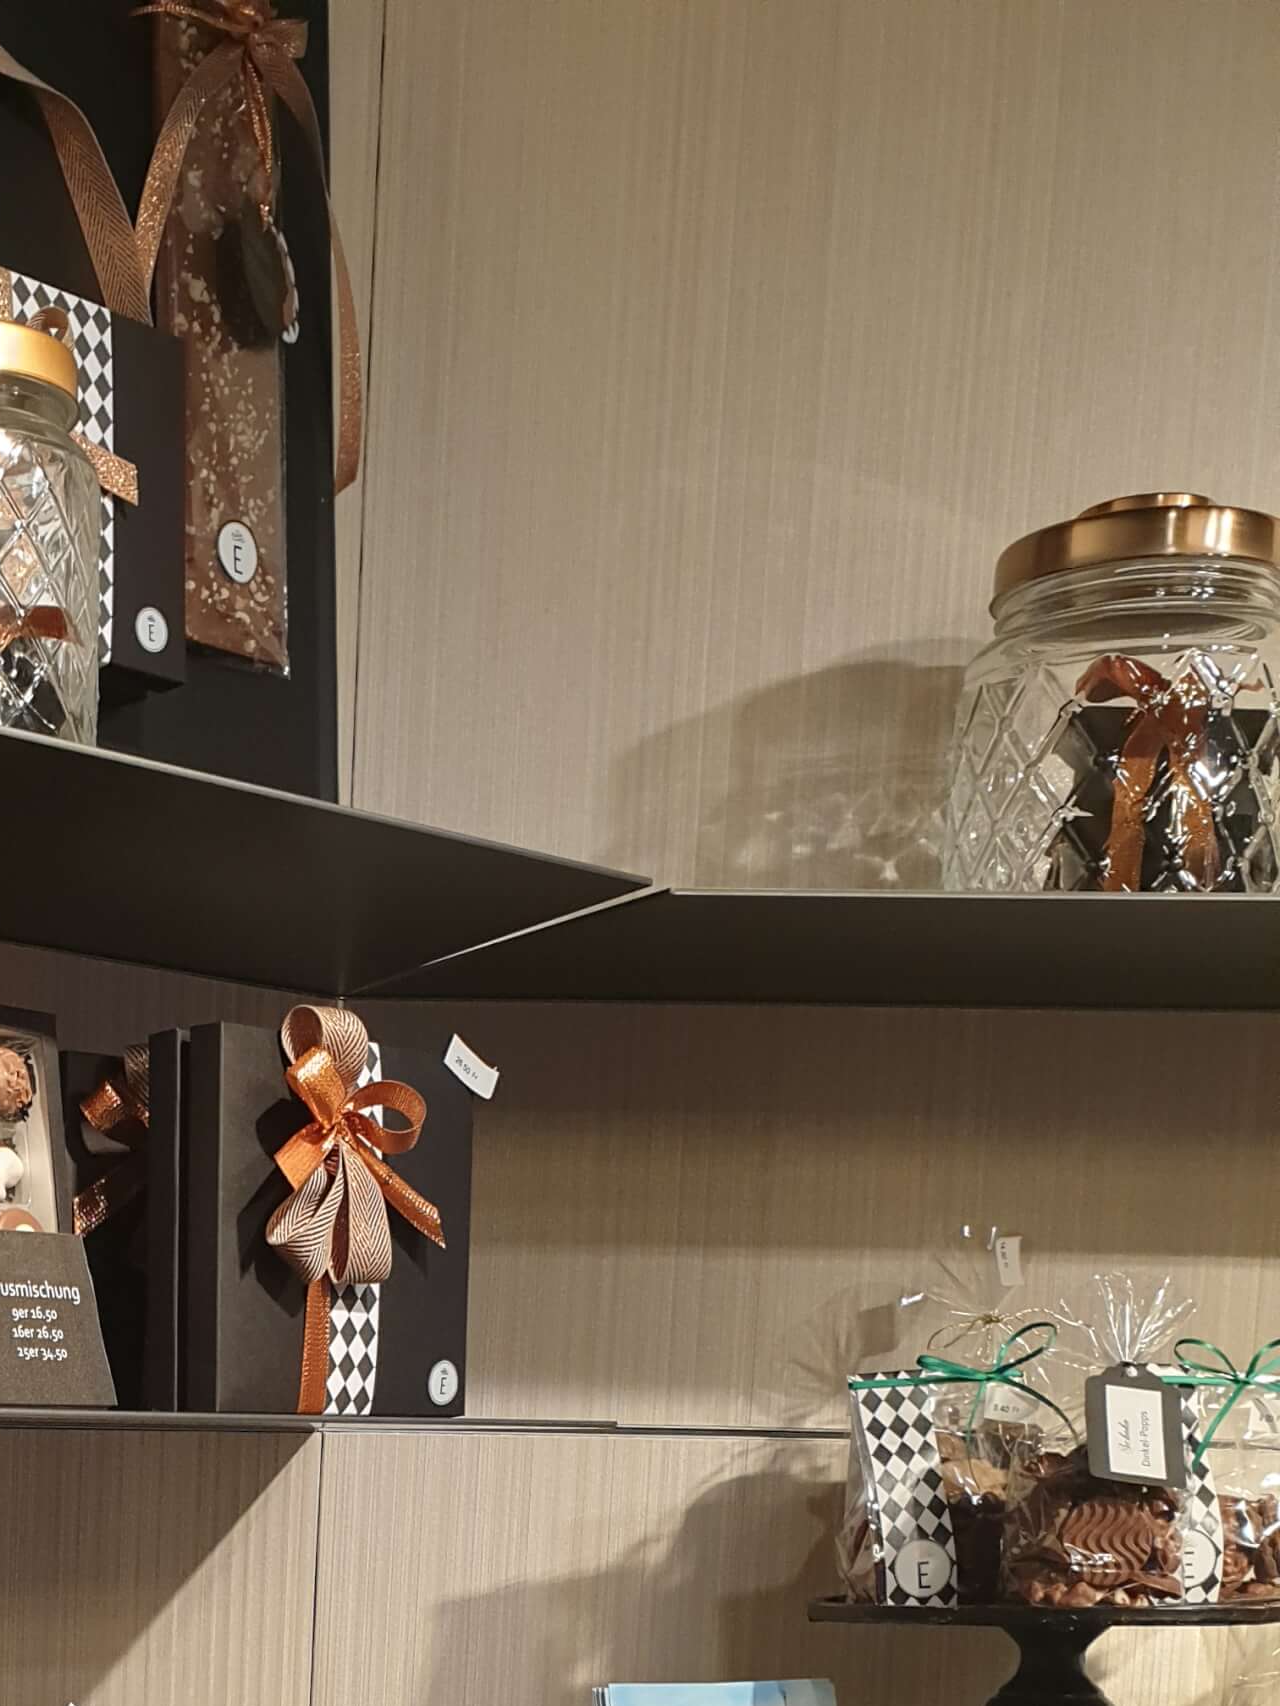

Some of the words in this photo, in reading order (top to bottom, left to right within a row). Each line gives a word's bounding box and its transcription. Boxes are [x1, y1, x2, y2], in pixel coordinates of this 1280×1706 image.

[11, 1307, 29, 1321] 9er
[30, 1306, 58, 1323] 16.50
[12, 1326, 35, 1340] 16er
[36, 1326, 64, 1342] 26.50
[17, 1346, 40, 1361] 25er
[40, 1347, 68, 1362] 34.50
[917, 1560, 932, 1589] E
